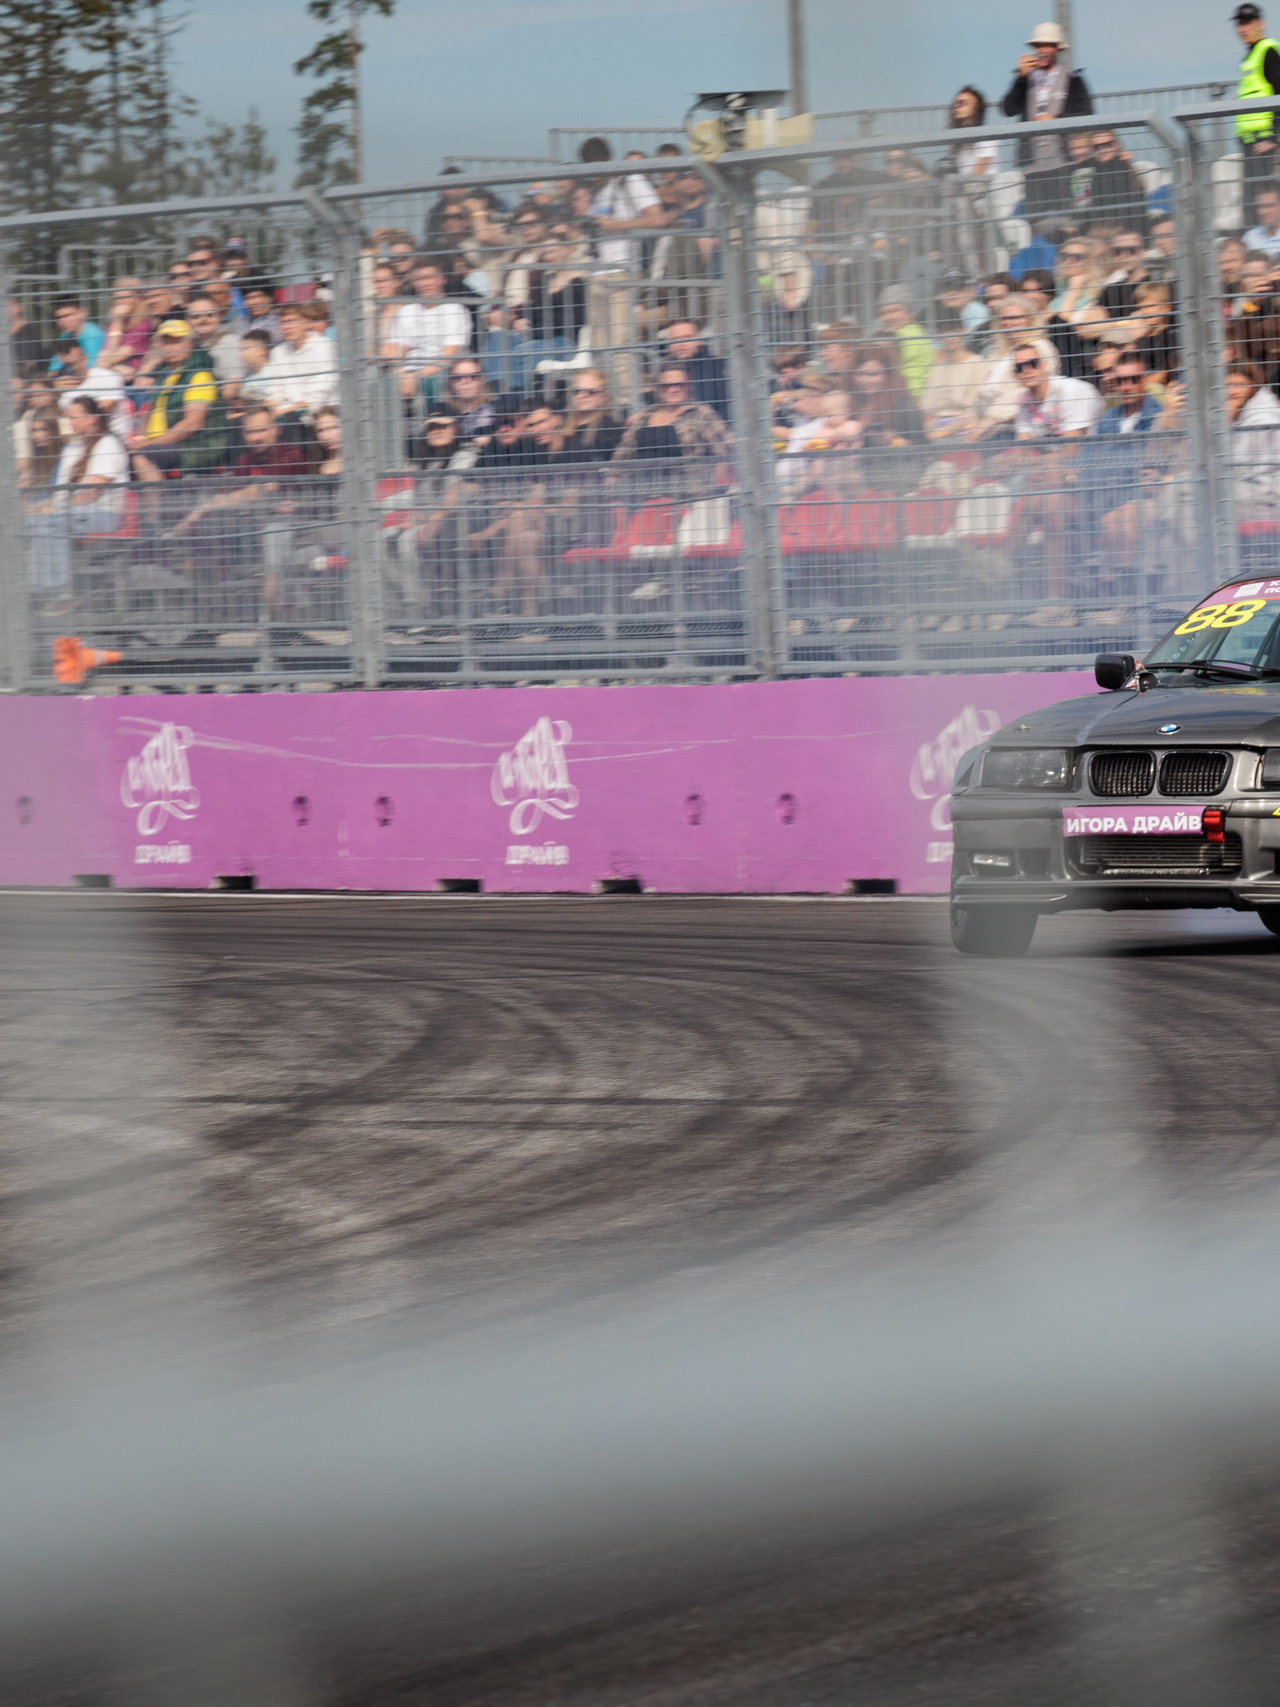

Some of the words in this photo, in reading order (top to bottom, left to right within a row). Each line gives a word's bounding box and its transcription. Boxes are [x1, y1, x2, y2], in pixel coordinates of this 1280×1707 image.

[1174, 599, 1266, 635] 88
[1067, 816, 1128, 833] ИГОРА
[1132, 812, 1202, 834] ДРАЙВ
